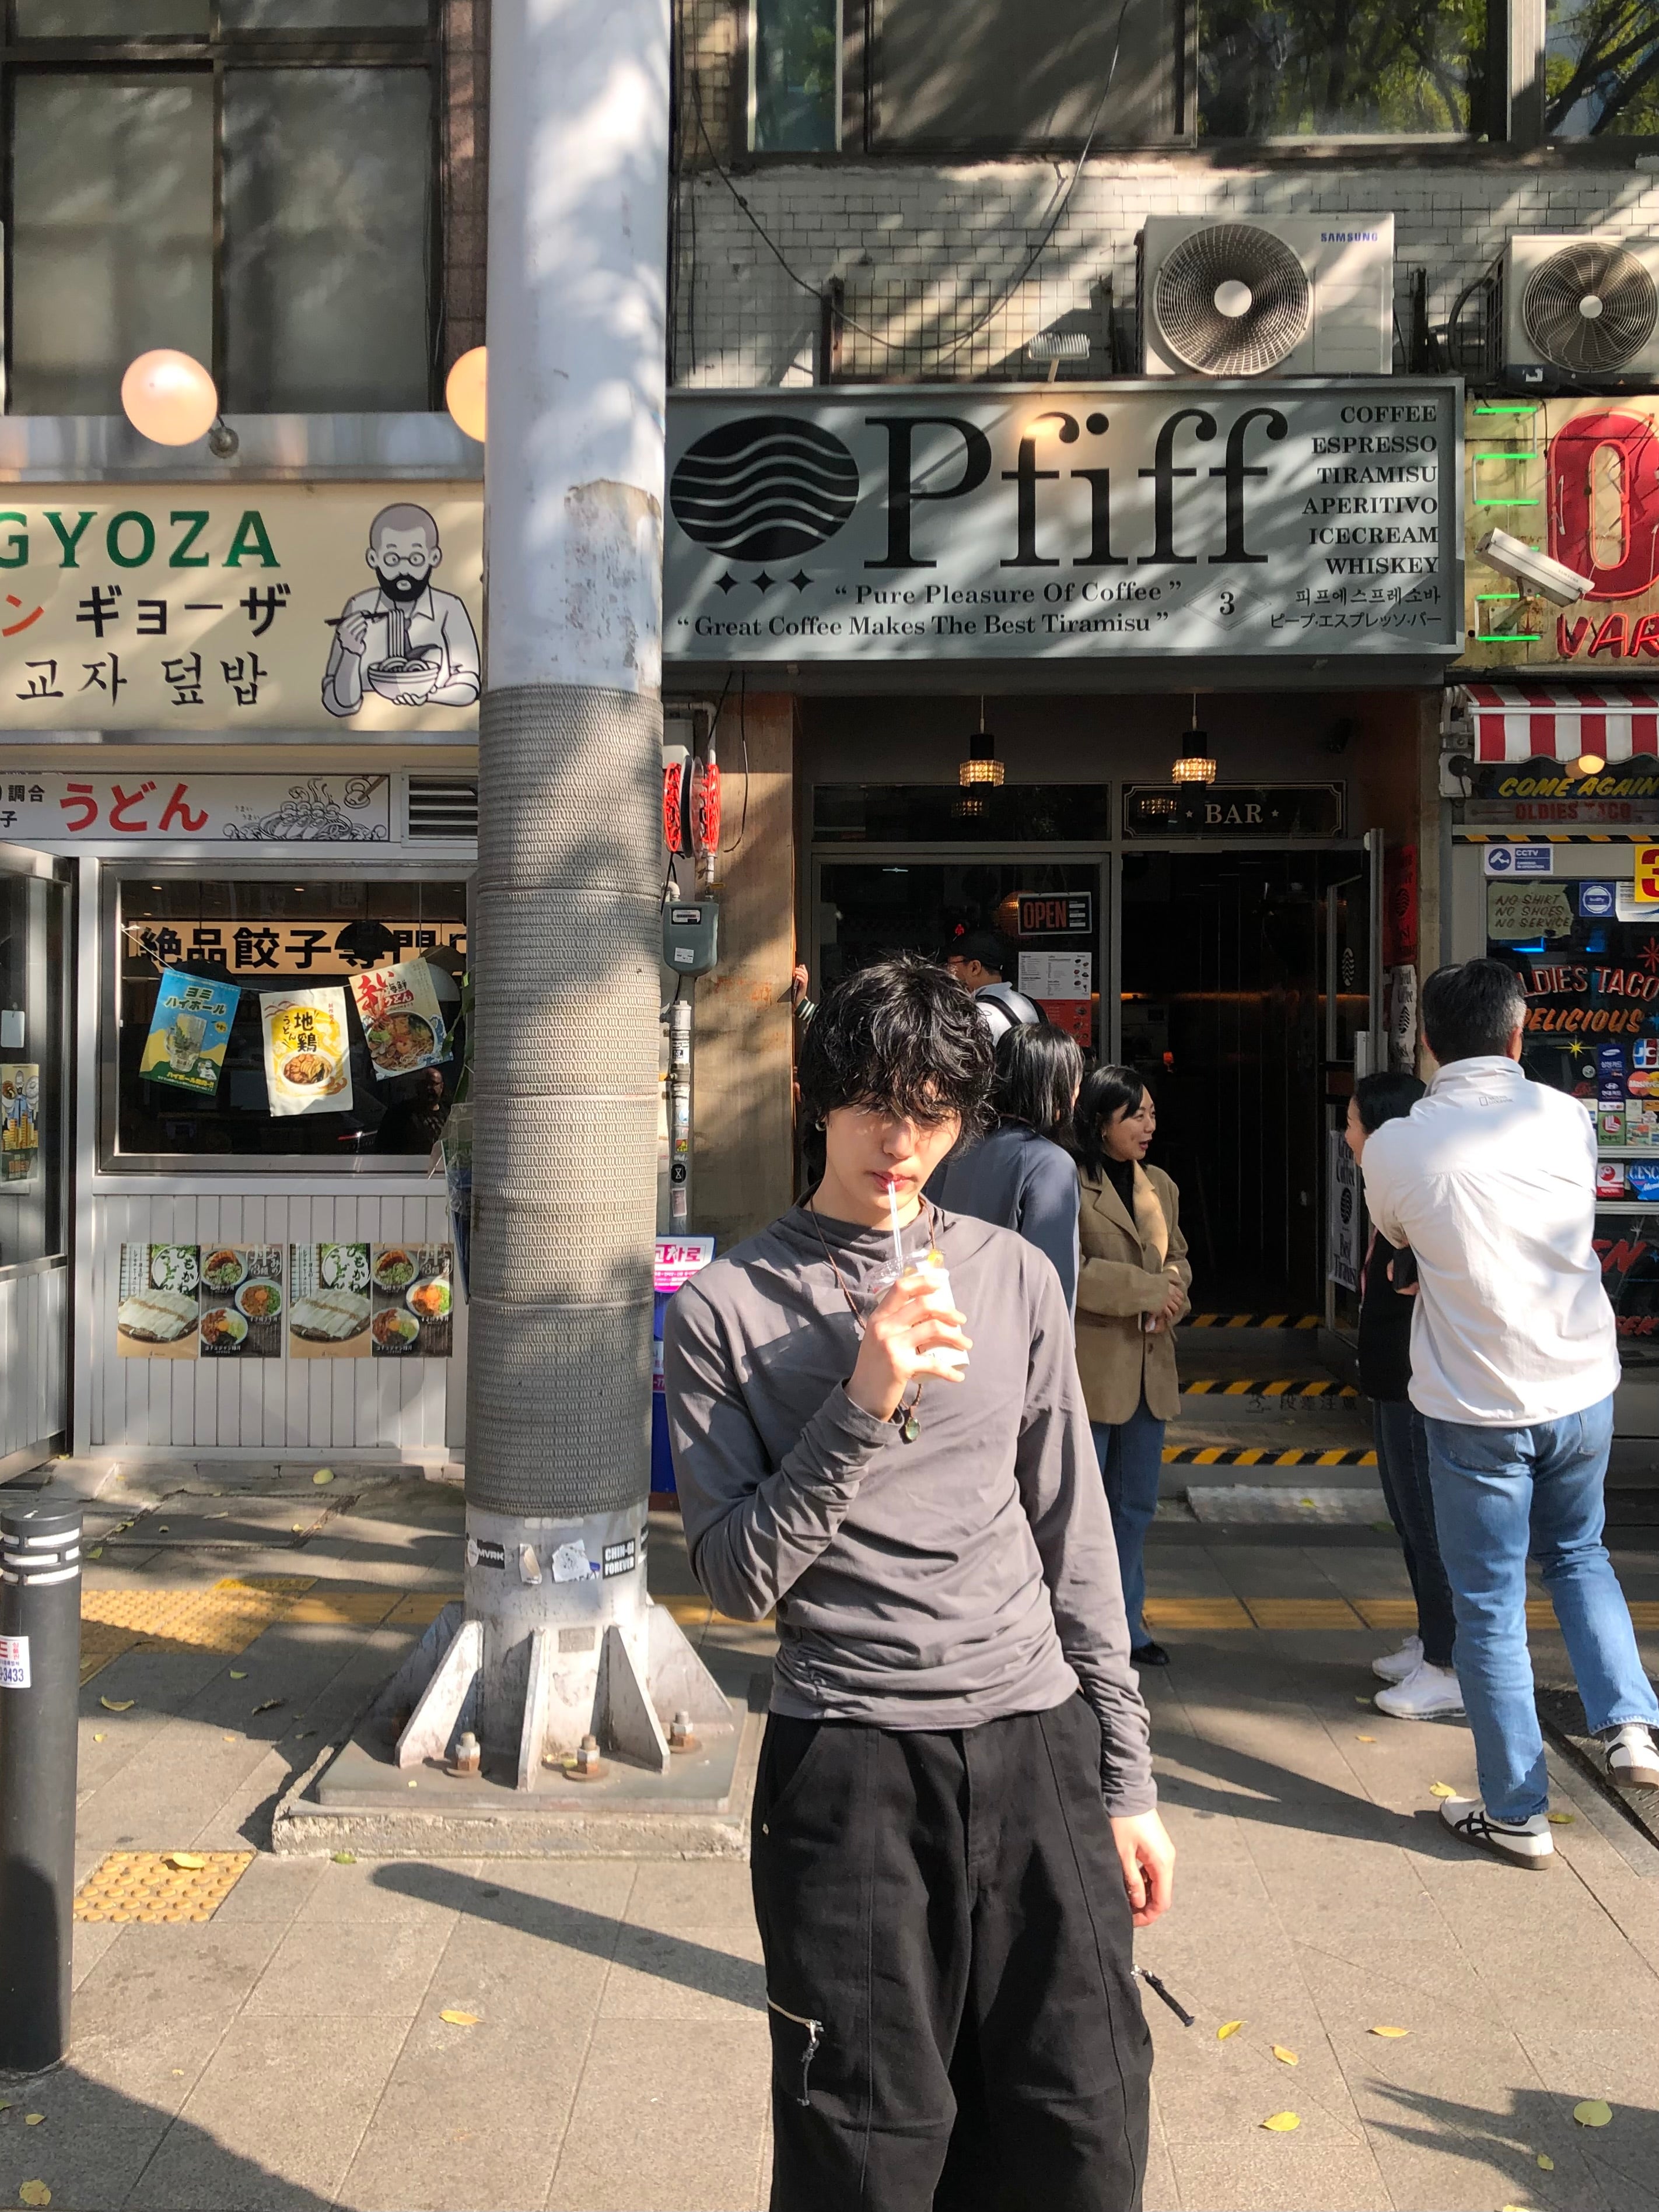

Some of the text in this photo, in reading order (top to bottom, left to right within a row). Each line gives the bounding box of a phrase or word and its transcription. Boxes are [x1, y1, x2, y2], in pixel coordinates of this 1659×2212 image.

[1321, 232, 1378, 243] SAMSUNG
[1340, 406, 1437, 423] COFFEE
[1312, 436, 1437, 453] ESPRESSO
[1317, 466, 1437, 483] TIRAMISU
[863, 408, 1288, 569] Pfiff
[1303, 496, 1438, 514] APERITIVO
[0, 510, 280, 568] GYOZA
[1308, 527, 1439, 545] ICECREAM
[1326, 557, 1439, 574] WHISKEY
[924, 585, 1035, 604] Pleasure
[1043, 584, 1076, 603] Of
[1219, 591, 1235, 615] 3
[76, 583, 290, 637] ギョーザ
[768, 616, 842, 636] Coffee
[849, 615, 925, 636] Makes
[932, 615, 978, 634] The
[985, 614, 1036, 634] Best
[15, 651, 268, 707] 교자 덮밥
[8, 784, 45, 802] 調合
[1499, 777, 1659, 797] COME AGAIN
[60, 780, 208, 832] うどん
[1205, 804, 1264, 824] BAR
[1516, 802, 1577, 820] OLDIES
[1495, 894, 1560, 906] NO SHIRT
[1023, 900, 1067, 929] OPEN
[1495, 905, 1564, 917] NO SHOES
[1494, 917, 1570, 928] NO SERVICE
[140, 926, 467, 969] 絶品餃子門
[185, 986, 212, 1000] ヨミ
[1517, 966, 1659, 1001] LDIES TACO
[283, 1016, 296, 1040] うどん
[293, 1012, 317, 1052] 地鶏
